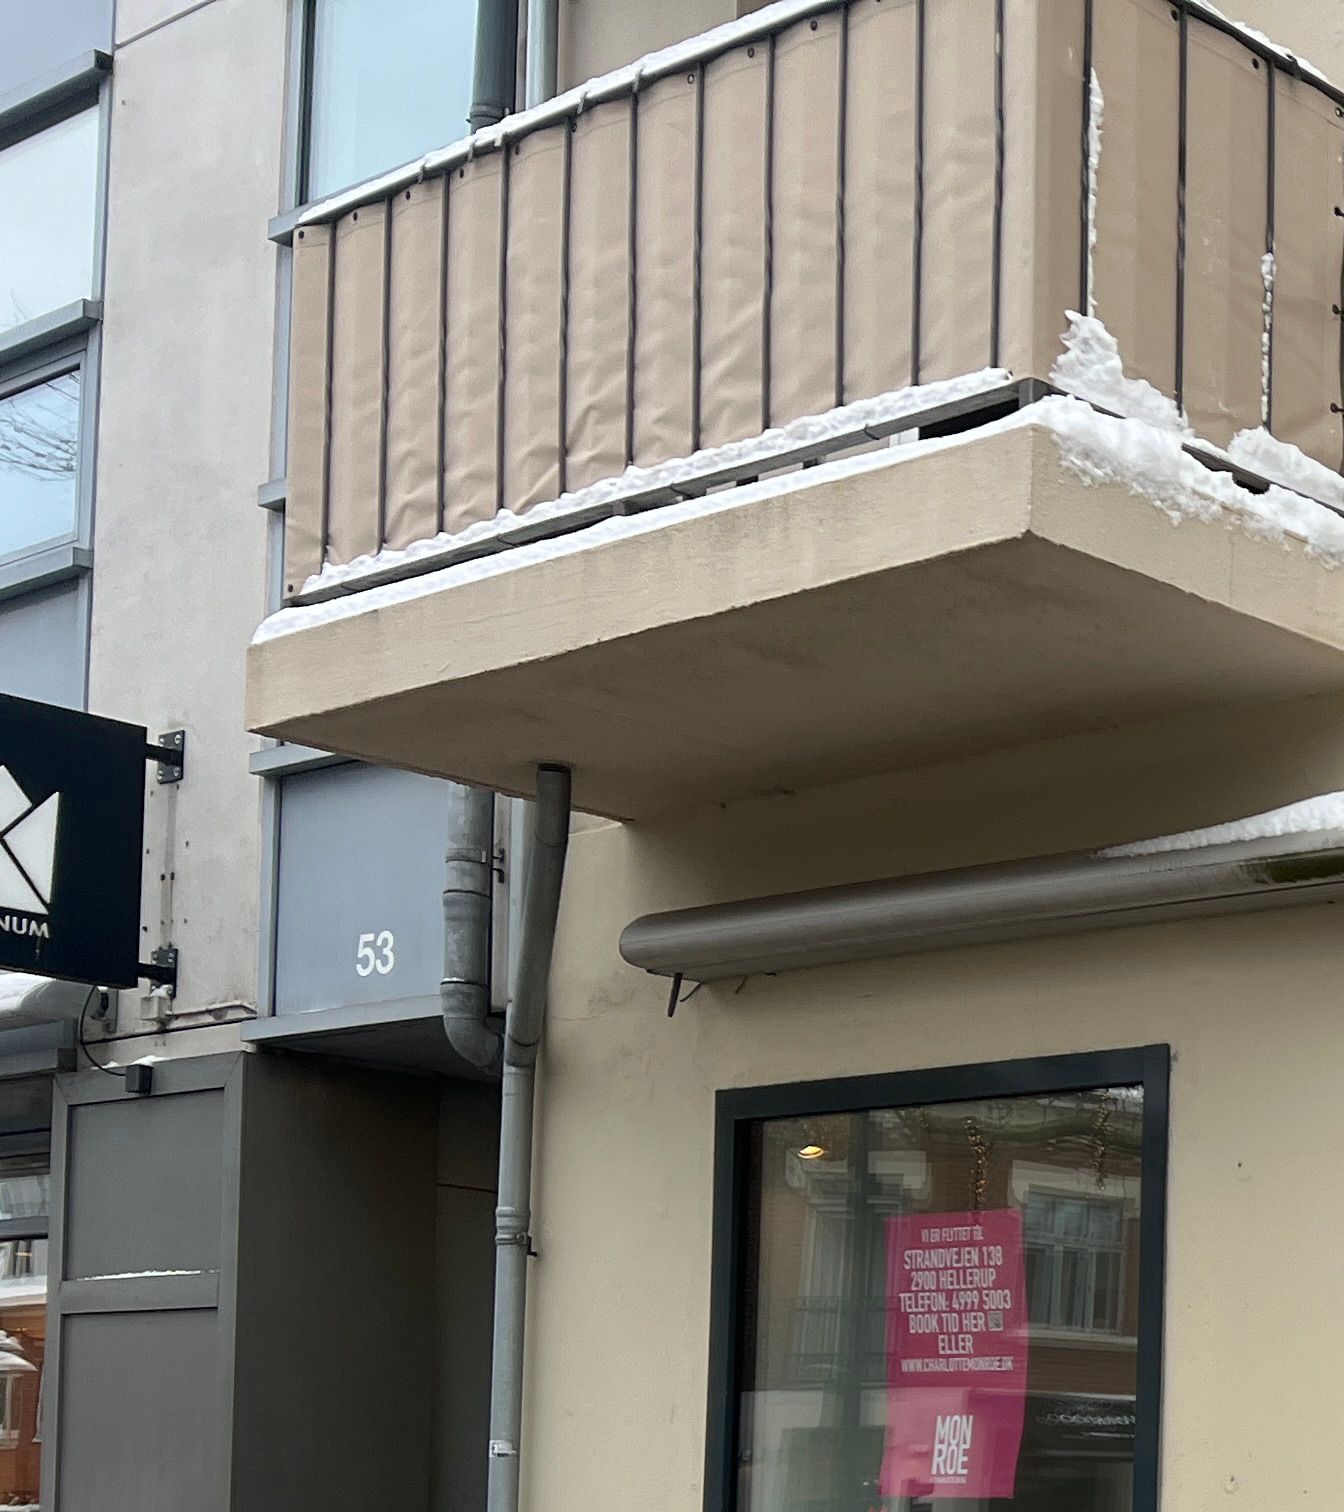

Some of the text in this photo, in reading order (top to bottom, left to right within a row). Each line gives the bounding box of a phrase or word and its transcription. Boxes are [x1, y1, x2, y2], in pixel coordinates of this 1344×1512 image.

[356, 930, 394, 977] 53
[904, 1246, 1003, 1270] STRANDVEJEN 138
[911, 1268, 996, 1291] 2900 HELLERUP
[899, 1289, 1012, 1313] TELEFON: 4999 5003
[909, 1312, 986, 1334] BOOK TID HER
[938, 1334, 974, 1355] ELLER
[936, 1415, 973, 1448] MON
[931, 1444, 969, 1475] ROE
